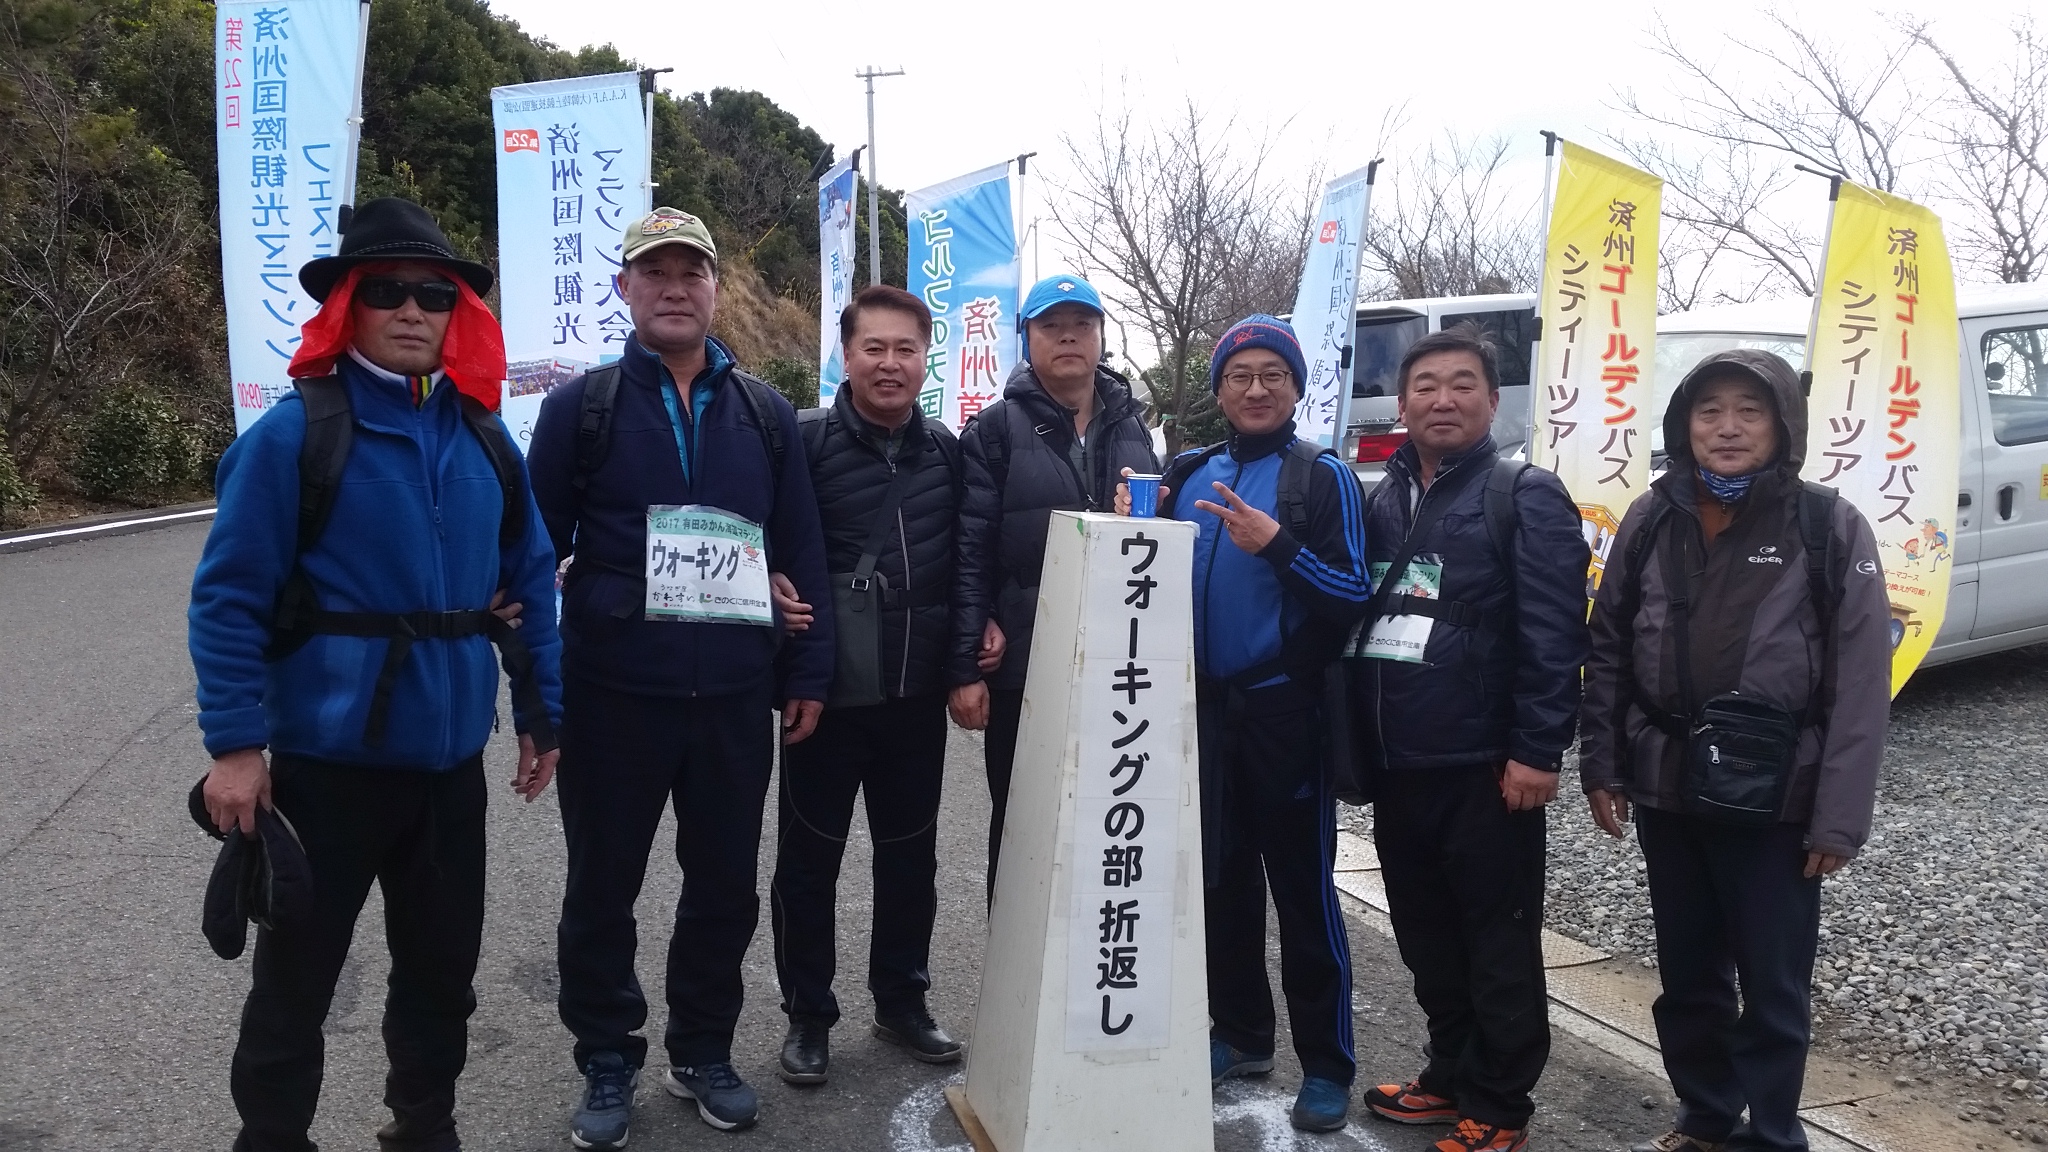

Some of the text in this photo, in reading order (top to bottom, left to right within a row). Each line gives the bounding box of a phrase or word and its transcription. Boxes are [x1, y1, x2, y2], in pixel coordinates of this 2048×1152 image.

[1597, 197, 1641, 490] 済州ゴールデンバス
[1878, 226, 1921, 526] 済州ゴールデンバス
[651, 539, 741, 582] ウォーキング
[655, 517, 680, 529] 2017
